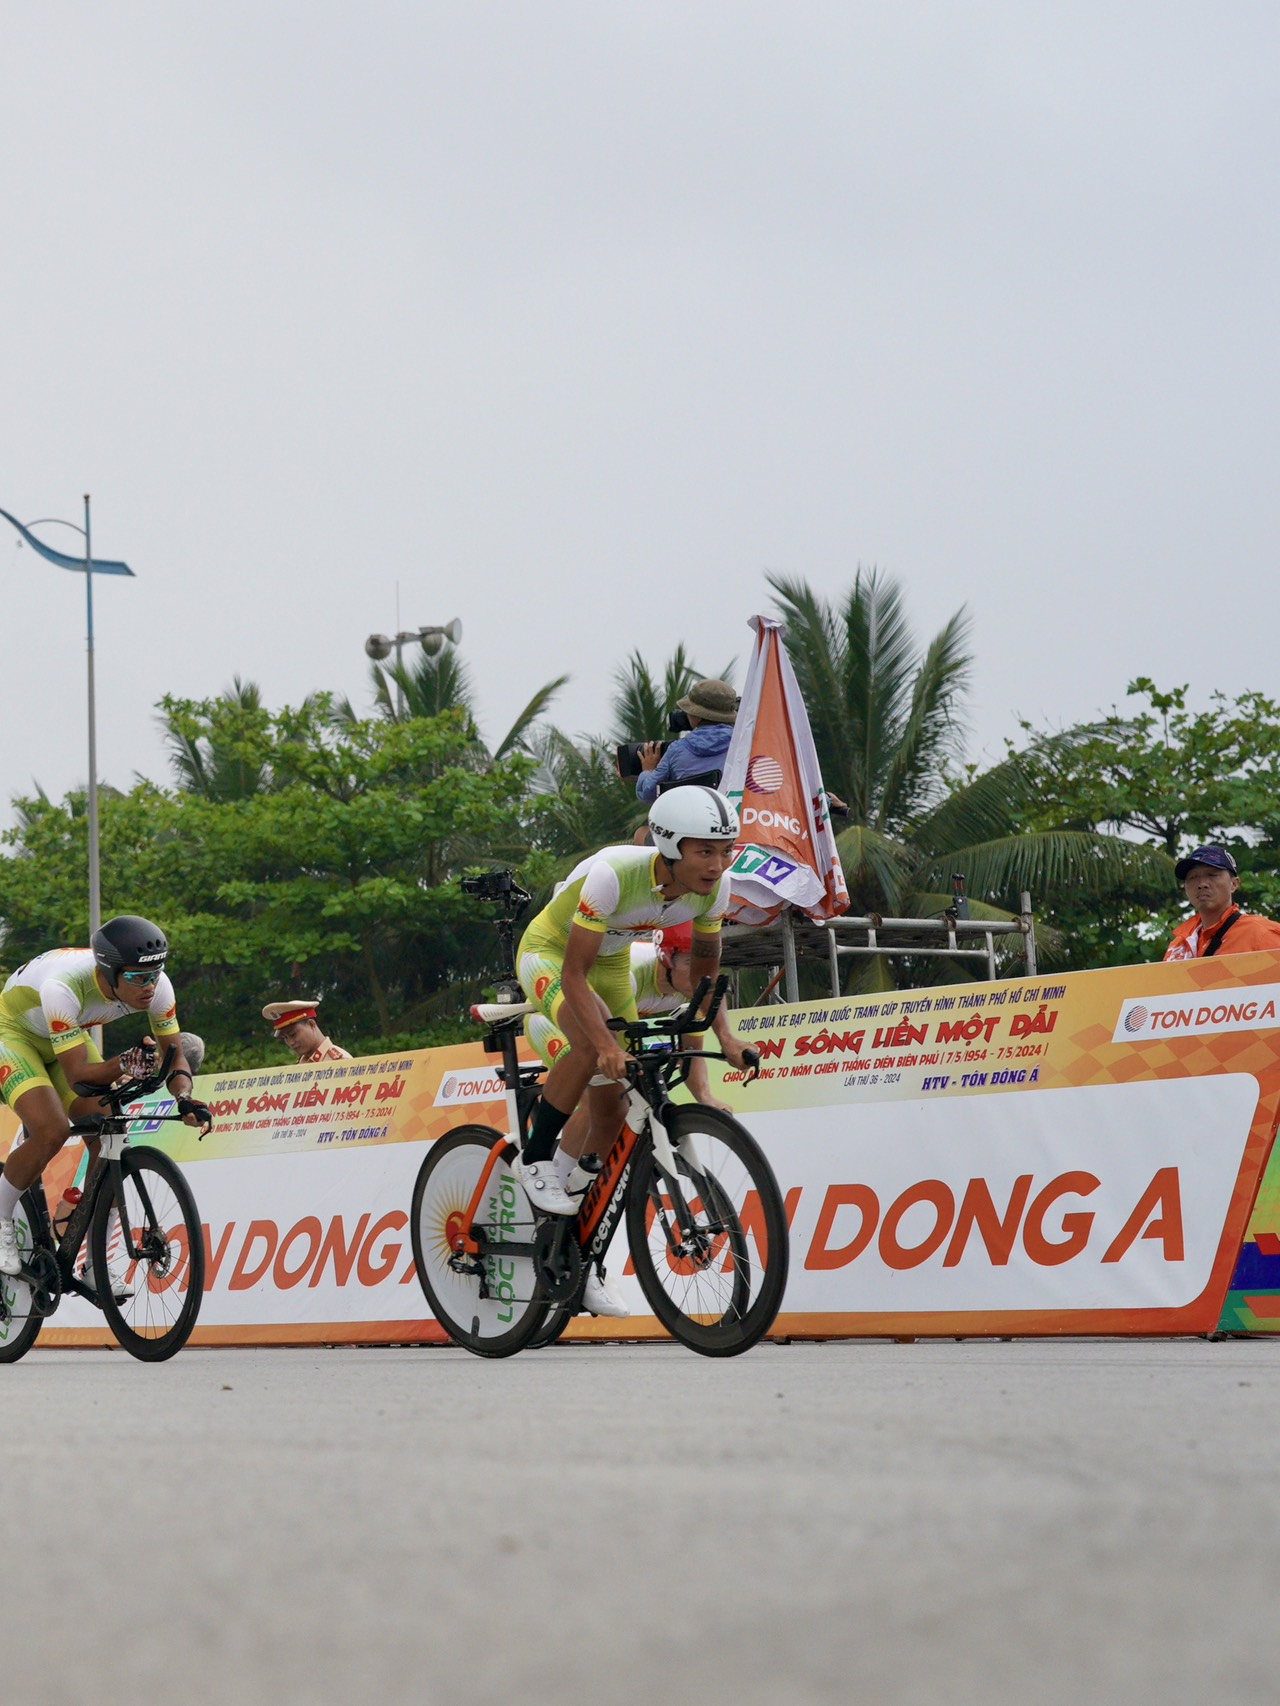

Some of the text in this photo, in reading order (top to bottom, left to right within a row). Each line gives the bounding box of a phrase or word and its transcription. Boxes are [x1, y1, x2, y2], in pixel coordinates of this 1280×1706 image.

[742, 807, 801, 836] DONG
[138, 951, 168, 963] GIANT
[738, 985, 1067, 1033] CUỘC ĐUA XE ĐẠP TOÀN QUỐC TRANH CÚP TRUYỀN HÌNH THÀNH PHỐ HỒ CHÍ MINH
[1150, 1000, 1276, 1030] TON DONG A
[751, 1004, 1059, 1060] ON SÔNG LIỀN MỘT DẢI
[777, 1066, 789, 1077] 70
[814, 1058, 840, 1075] CHIẾN
[896, 1053, 916, 1068] BIÊN
[947, 1049, 988, 1064] 7/5/1954
[997, 1044, 1043, 1059] 7/5/2024
[456, 1080, 484, 1097] TON
[870, 1075, 879, 1084] 36
[884, 1073, 901, 1084] 2024
[921, 1076, 950, 1091] HTV
[960, 1070, 988, 1088] TÔN
[990, 1068, 1026, 1086] ĐÔNG
[208, 1074, 407, 1117] NON SÔNG LIỀN MỘT DẢI
[317, 1131, 336, 1144] HTV
[803, 1170, 1102, 1270] DONG
[1100, 1166, 1185, 1264] A
[228, 1209, 409, 1292] DONG
